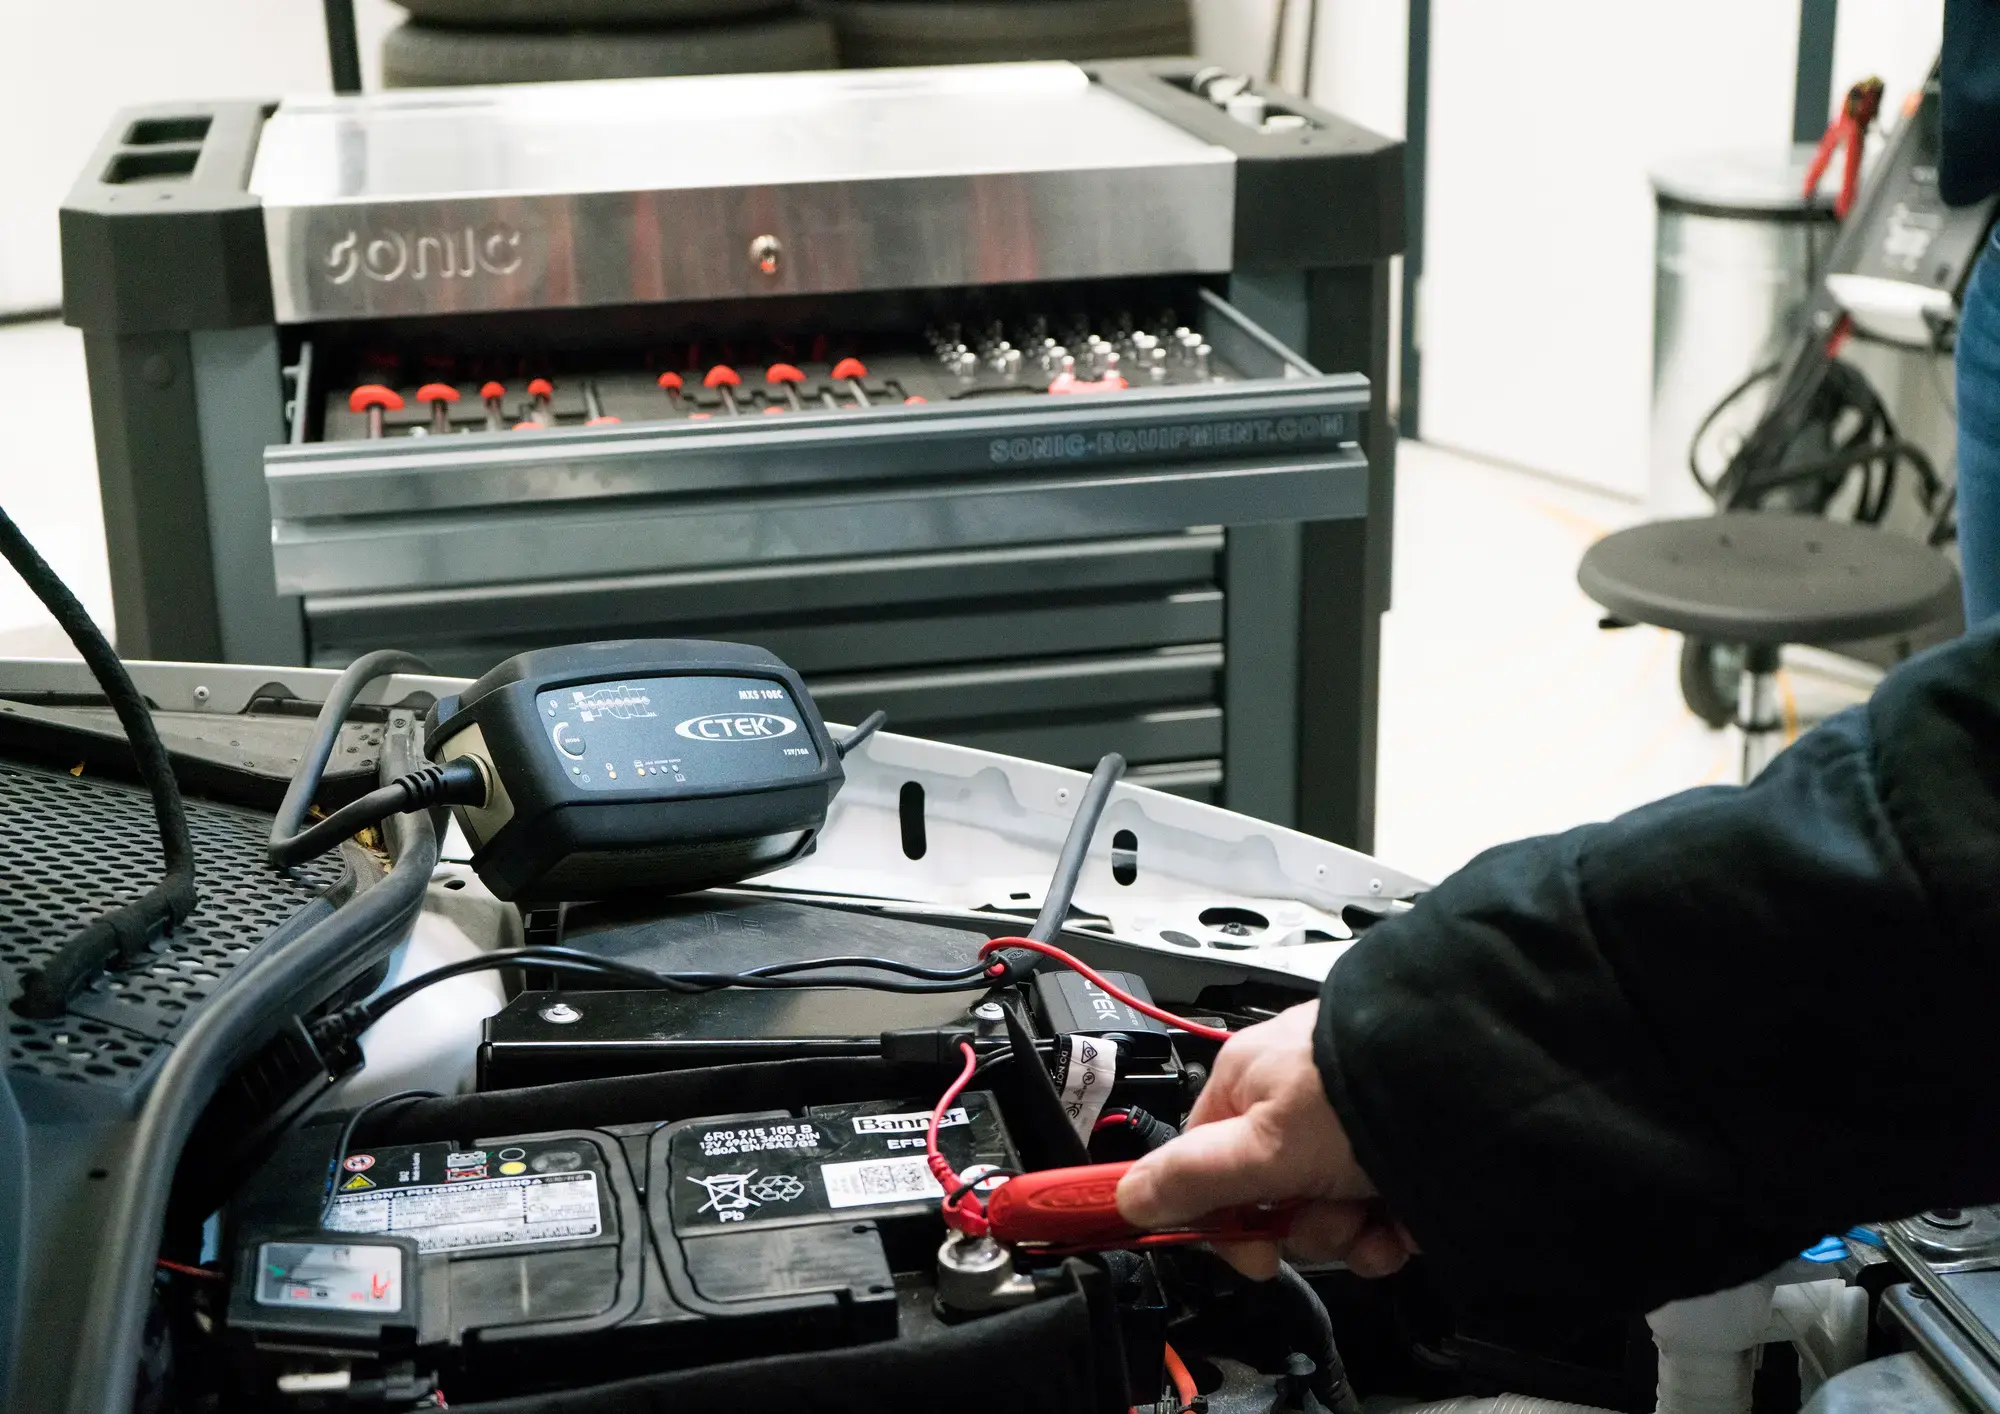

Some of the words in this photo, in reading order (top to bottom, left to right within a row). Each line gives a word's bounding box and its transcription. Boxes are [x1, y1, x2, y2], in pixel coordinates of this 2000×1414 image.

[989, 413, 1345, 463] SONIC-EQUIPMENT.COM
[738, 690, 760, 700] MXS
[698, 717, 773, 738] CTEK
[703, 1131, 735, 1142] 6R0
[737, 1127, 766, 1139] 915
[769, 1125, 797, 1136] 105
[800, 1124, 812, 1134] B
[699, 1140, 722, 1150] 12V
[796, 1132, 820, 1141] DIN
[886, 1138, 927, 1150] EFB
[704, 1146, 739, 1156] 680A
[719, 1210, 745, 1223] Pb
